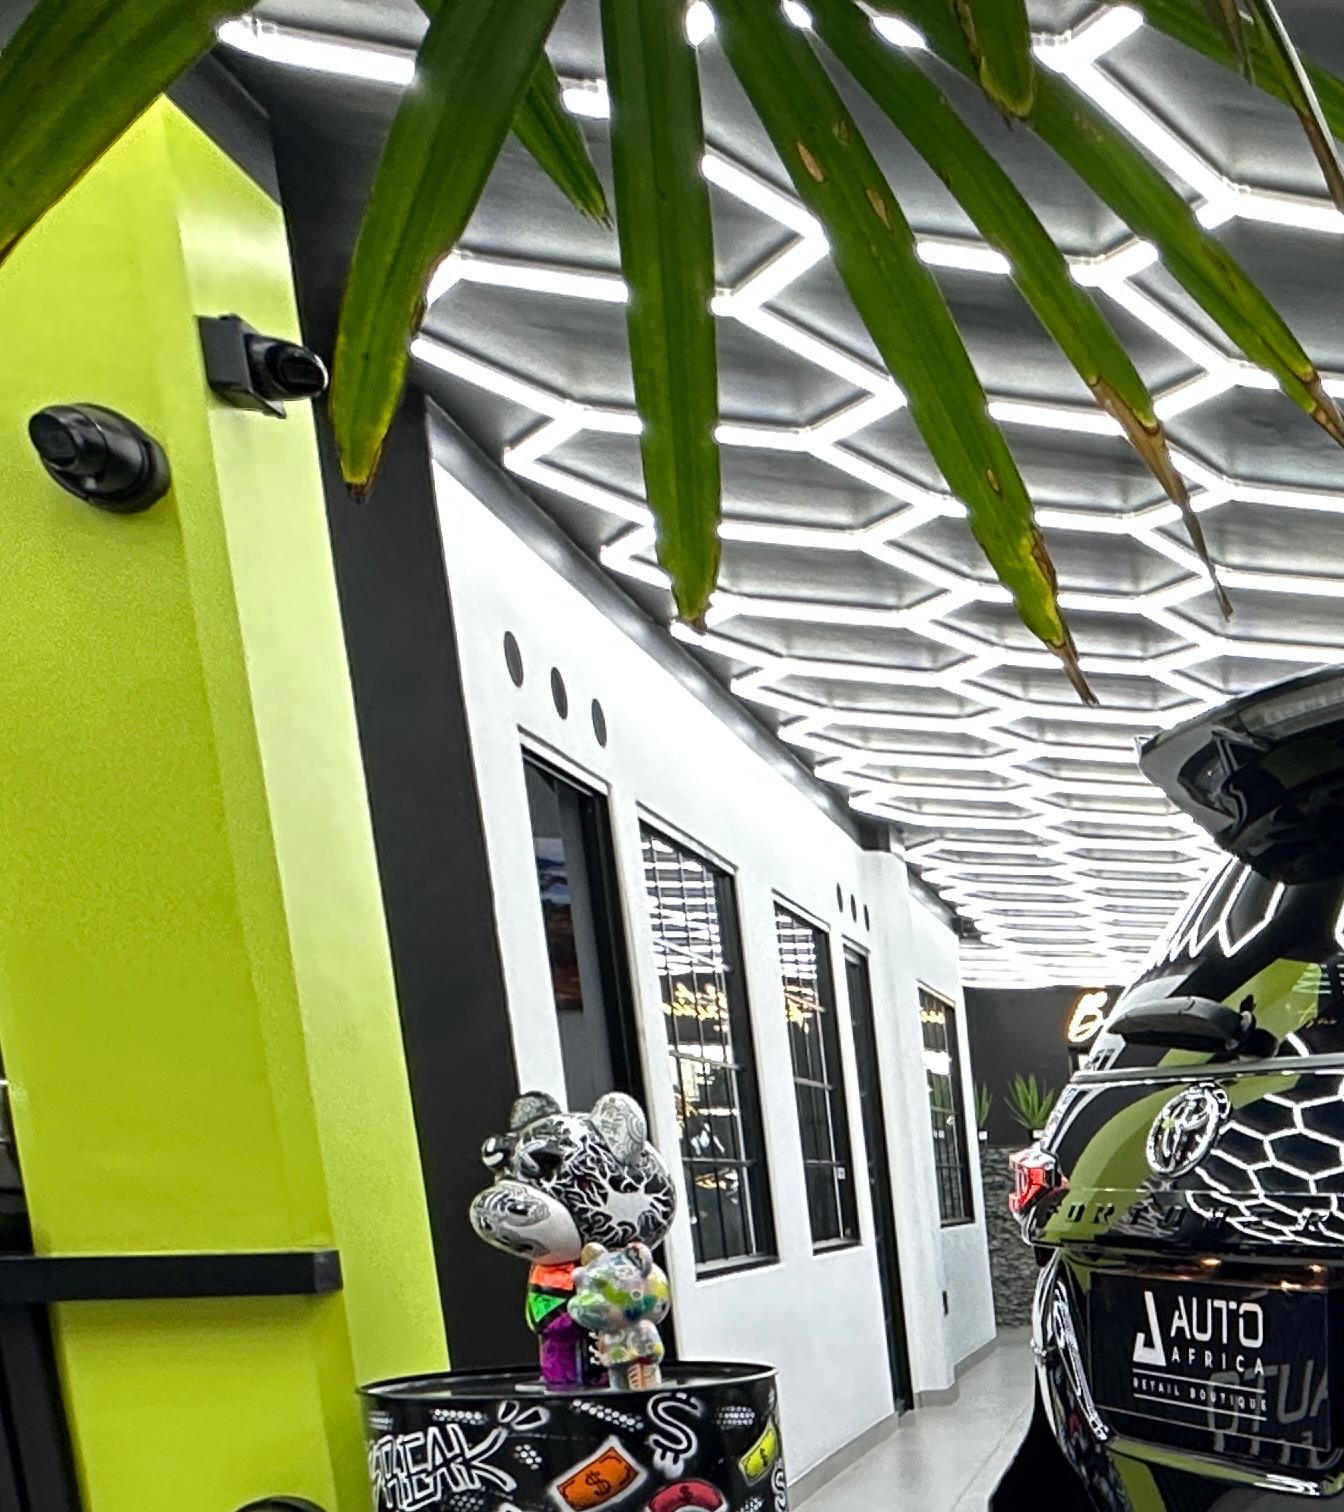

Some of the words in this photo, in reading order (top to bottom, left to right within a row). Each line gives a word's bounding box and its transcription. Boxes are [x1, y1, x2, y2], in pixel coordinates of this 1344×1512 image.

[1170, 1295, 1264, 1348] AUTO
[1171, 1346, 1265, 1376] AFRICA
[1132, 1376, 1181, 1396] RETAIL
[1189, 1387, 1268, 1412] BOUTIQUE
